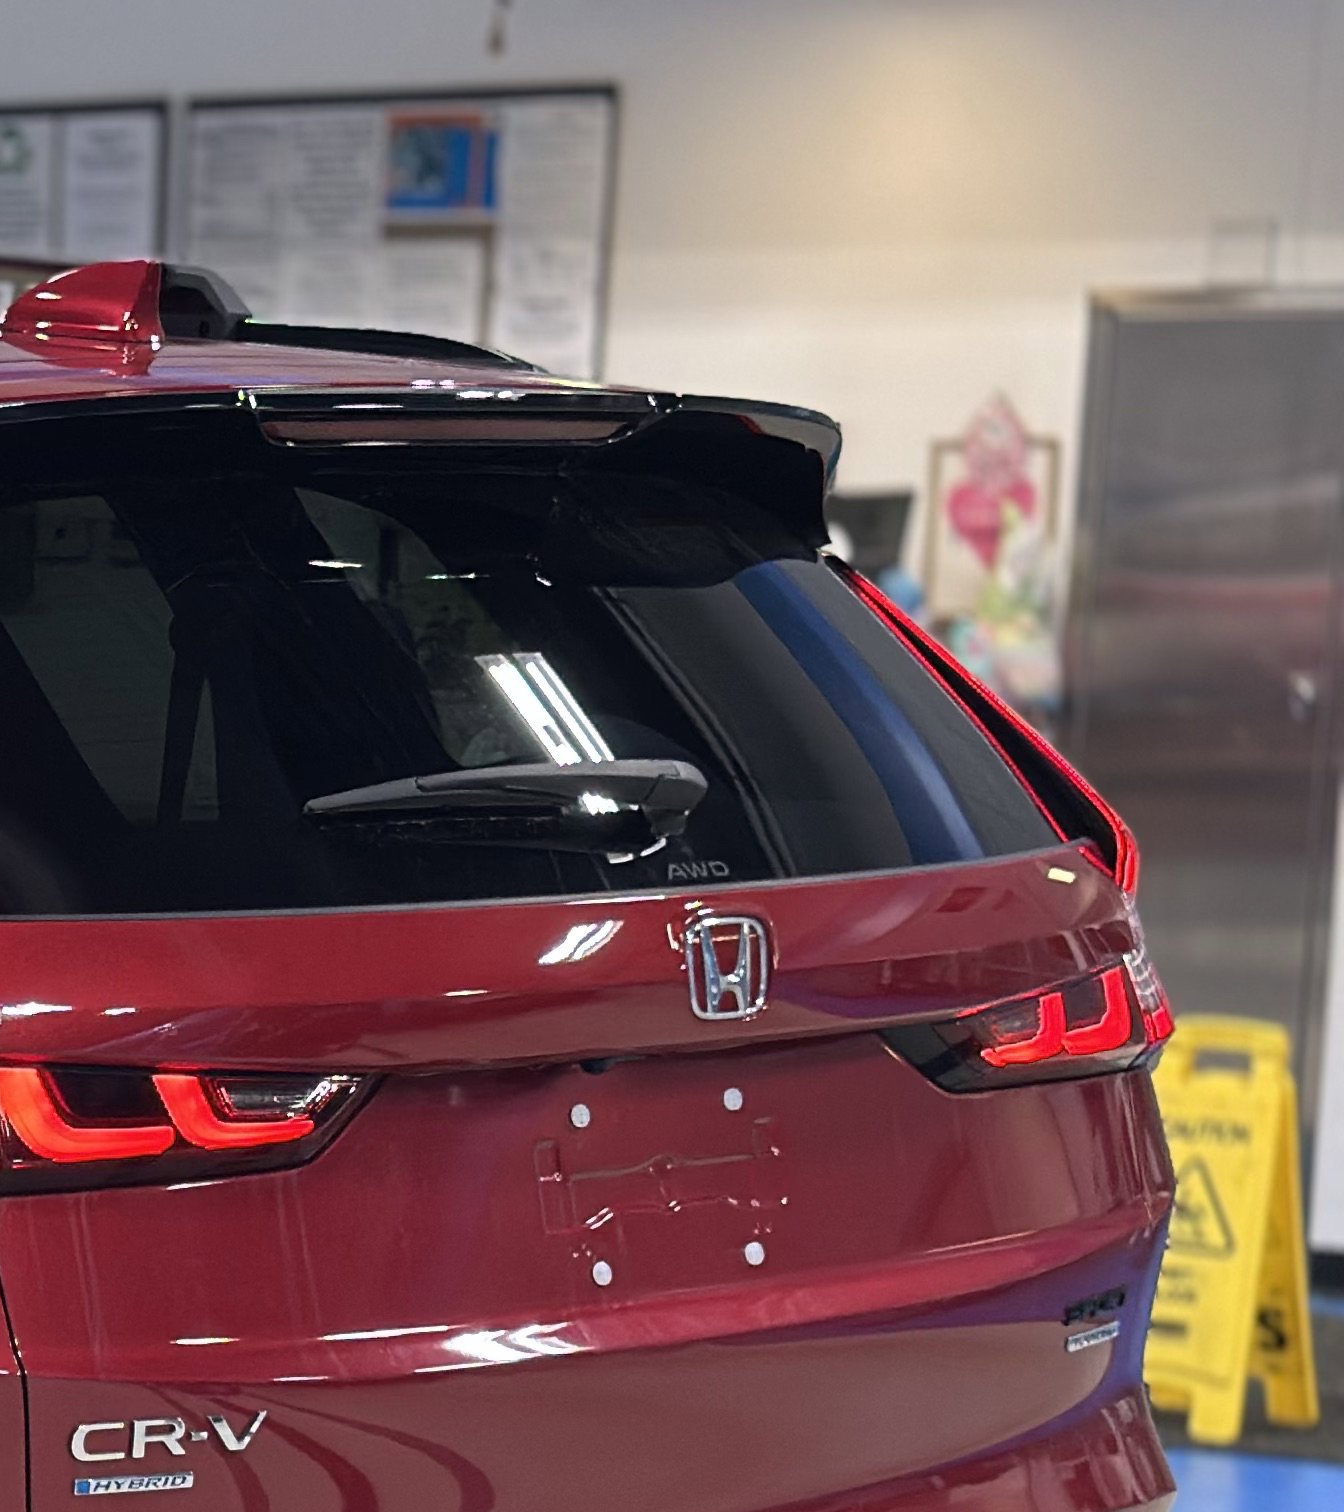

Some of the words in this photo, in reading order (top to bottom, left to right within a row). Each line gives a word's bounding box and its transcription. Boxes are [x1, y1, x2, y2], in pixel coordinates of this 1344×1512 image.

[668, 861, 730, 880] AWD
[71, 1410, 267, 1462] CR-V
[93, 1475, 188, 1492] HYBRID
